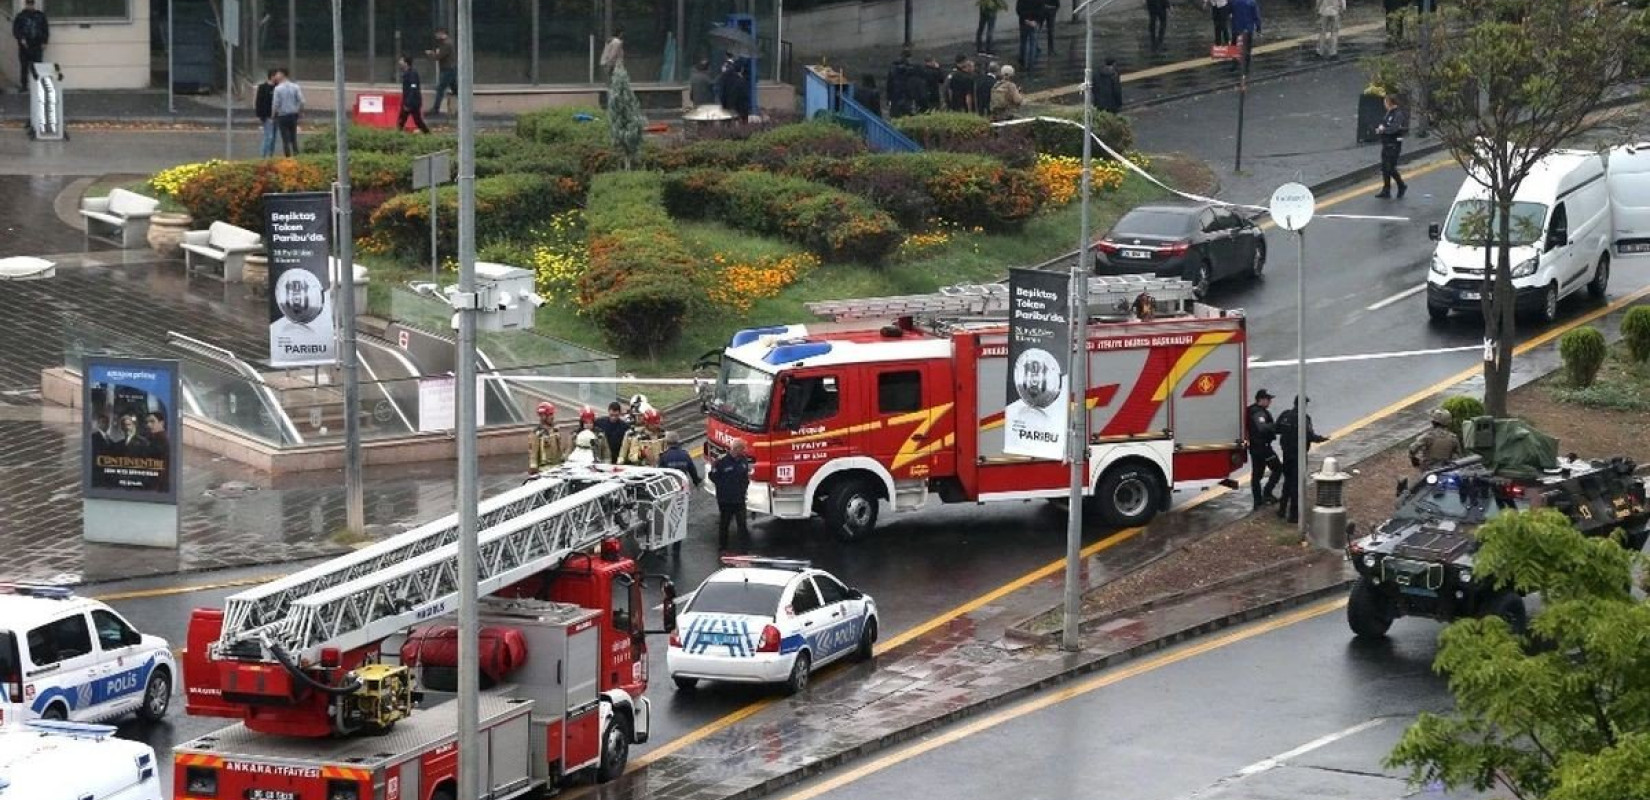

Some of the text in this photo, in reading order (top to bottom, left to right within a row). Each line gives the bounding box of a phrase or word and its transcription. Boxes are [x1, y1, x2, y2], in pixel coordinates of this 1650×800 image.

[272, 211, 316, 222] Beşiktaş
[272, 223, 303, 231] Token
[1016, 287, 1058, 301] Beşiktaş
[1016, 299, 1046, 309] Token
[189, 687, 222, 696] MAGIRU
[226, 762, 272, 774] ANKARA
